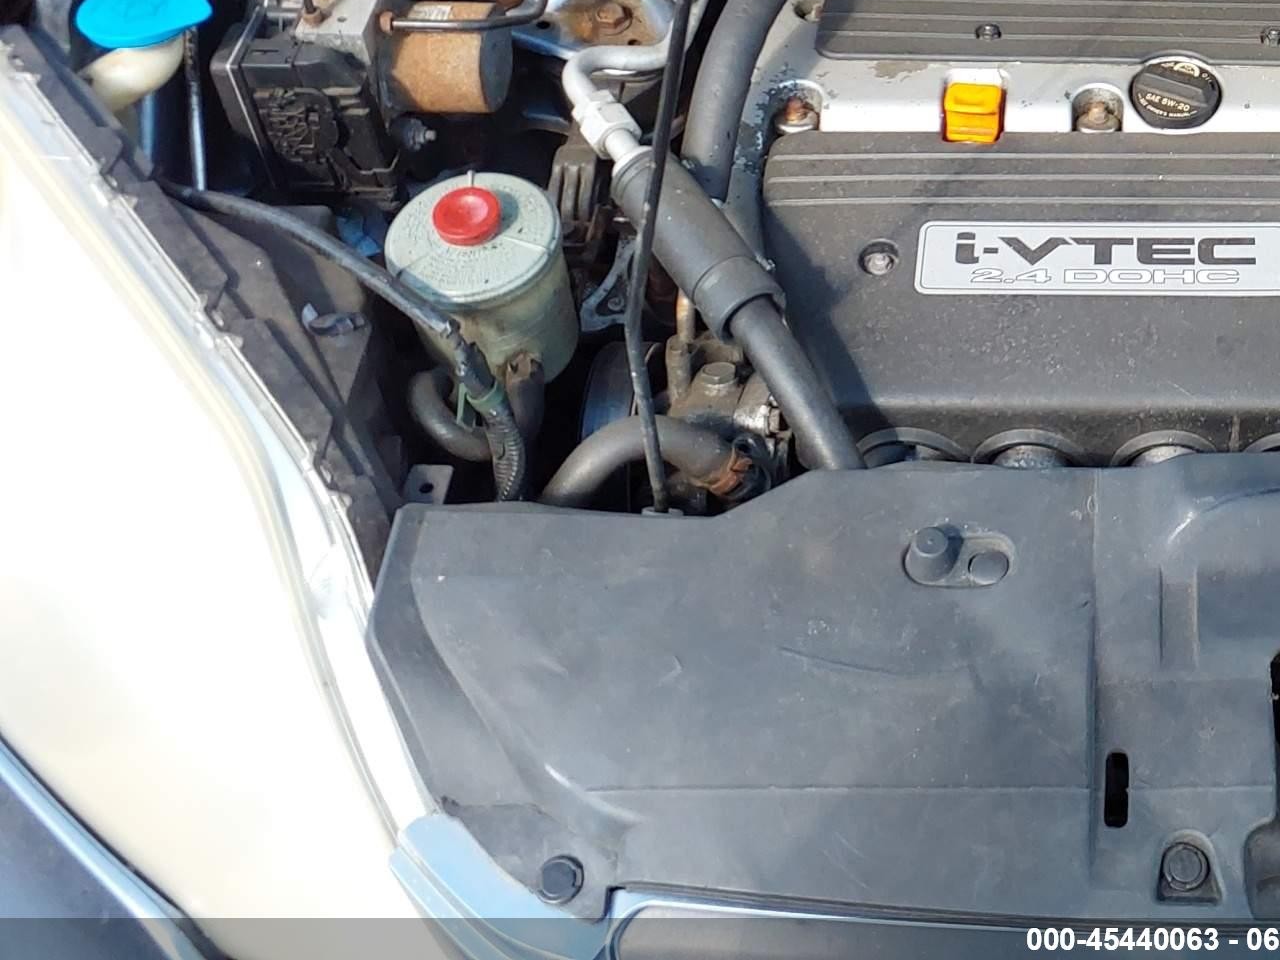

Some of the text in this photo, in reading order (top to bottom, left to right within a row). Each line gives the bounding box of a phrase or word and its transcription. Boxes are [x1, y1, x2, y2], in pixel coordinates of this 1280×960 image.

[955, 231, 1256, 265] i-VTEC
[970, 267, 1240, 284] 2.4 DOHC
